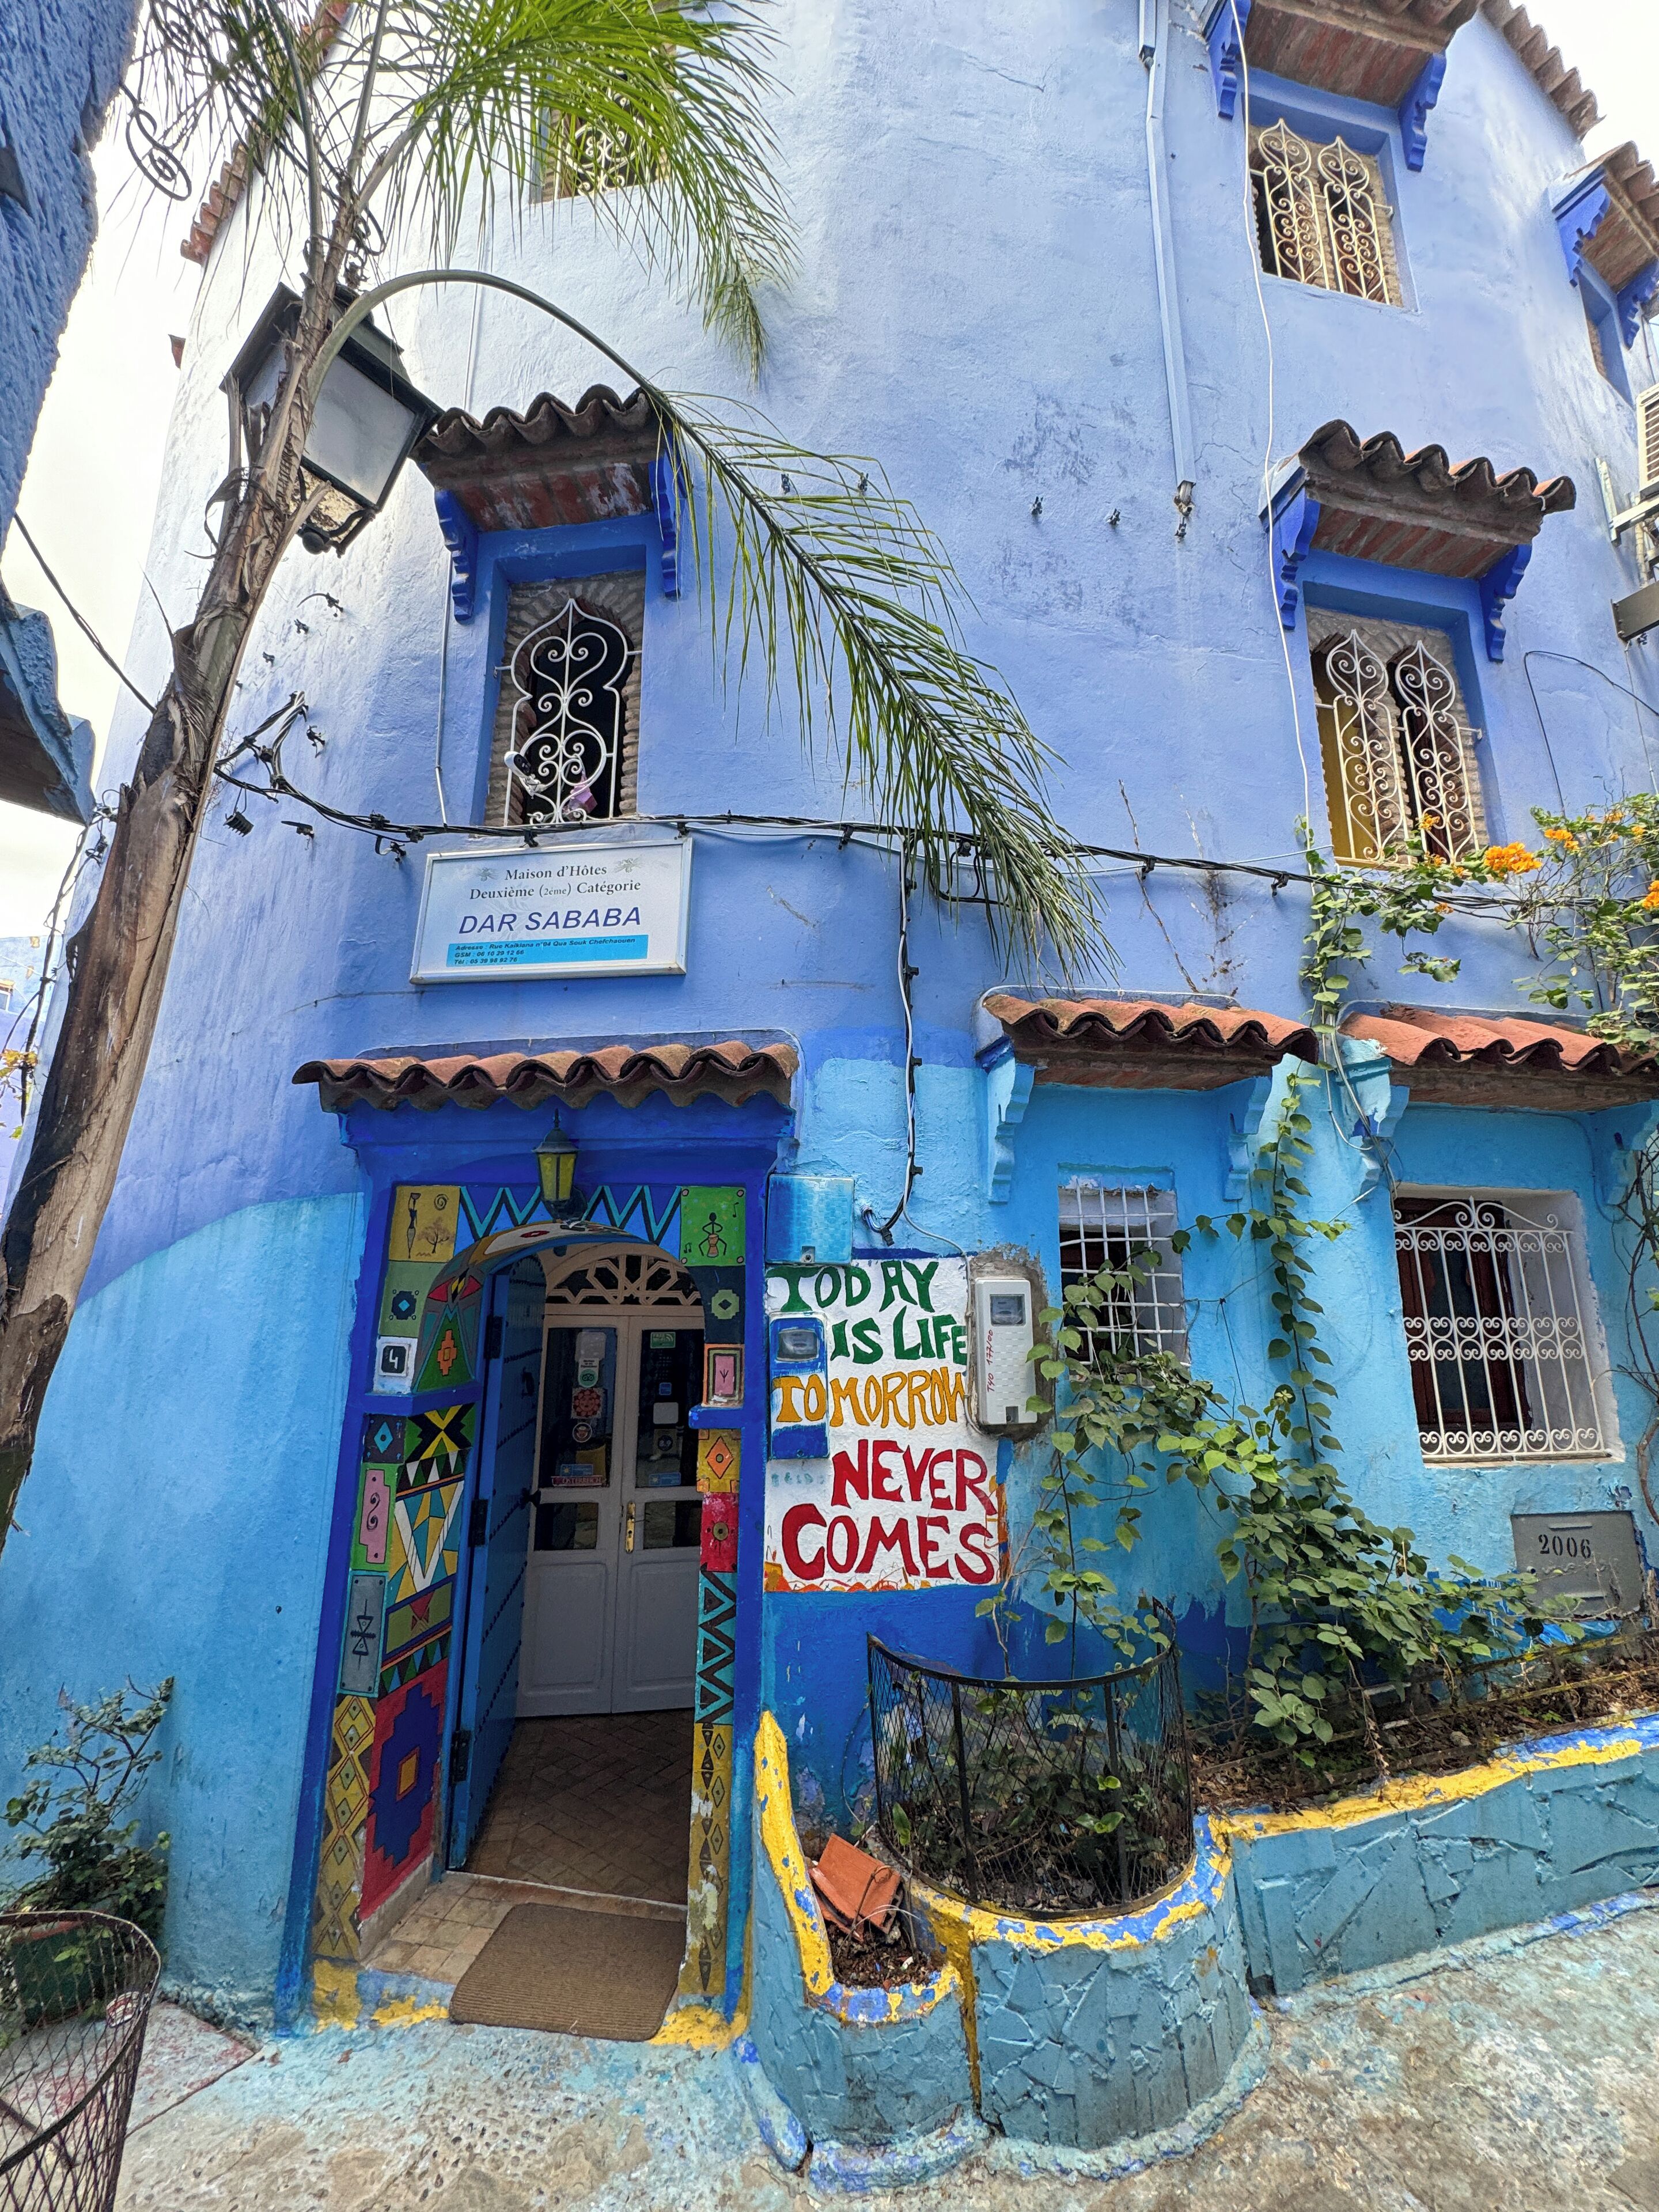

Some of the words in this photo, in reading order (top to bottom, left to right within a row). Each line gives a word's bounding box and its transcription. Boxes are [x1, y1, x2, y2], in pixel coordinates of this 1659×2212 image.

[469, 887, 535, 900] Deuxième
[577, 880, 641, 895] Catégorie
[505, 869, 552, 881] Maison
[459, 914, 517, 934] DAR
[525, 907, 641, 931] SABABA
[766, 1260, 940, 1313] TODAY
[830, 1317, 884, 1365] IS
[892, 1306, 967, 1365] LIFE
[389, 1349, 399, 1369] 4
[772, 1366, 967, 1430] TOMORROW
[830, 1439, 998, 1516] NEVER
[781, 1503, 995, 1585] COMES
[1538, 1534, 1592, 1559] 2006
